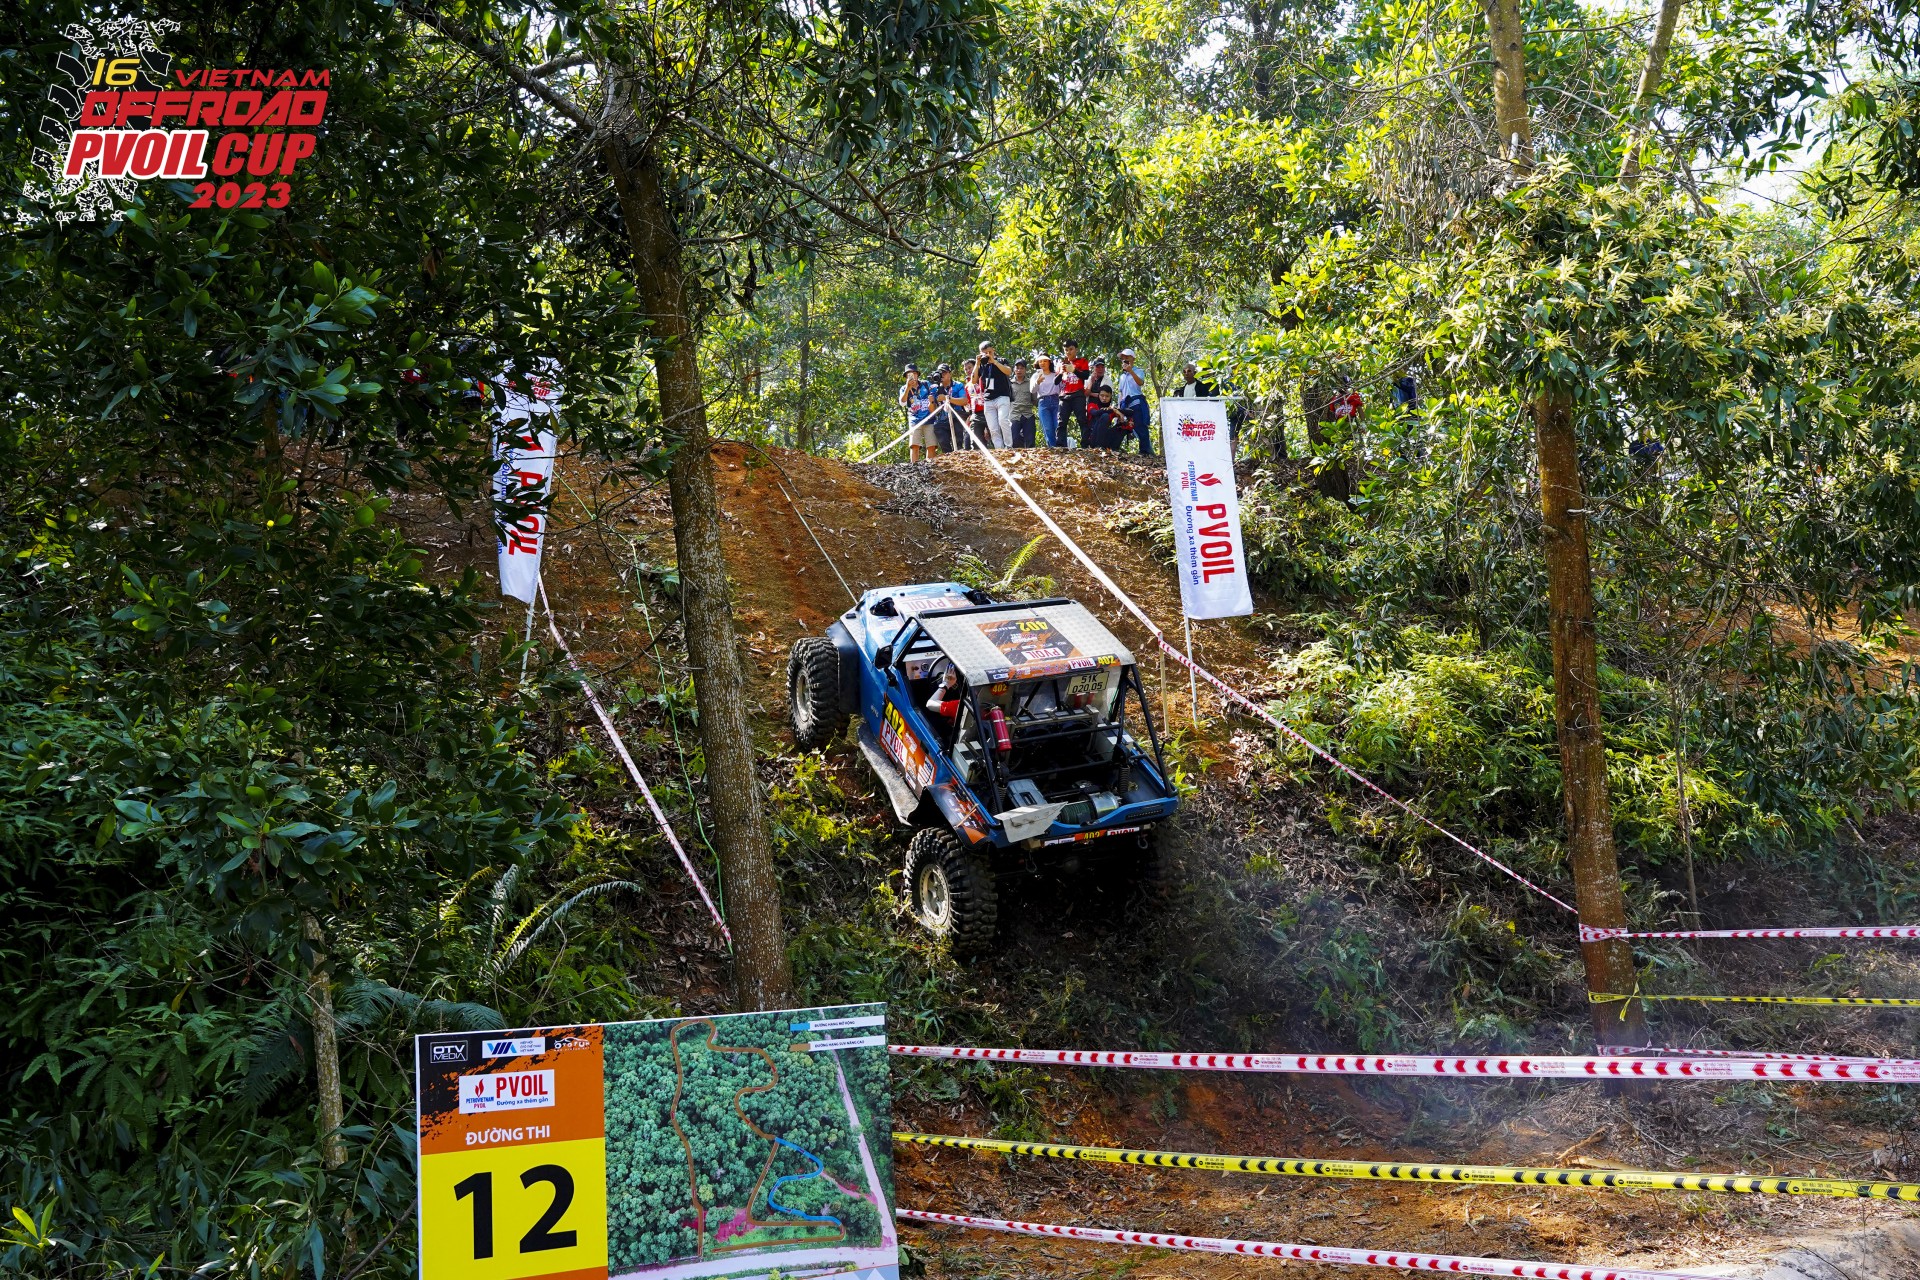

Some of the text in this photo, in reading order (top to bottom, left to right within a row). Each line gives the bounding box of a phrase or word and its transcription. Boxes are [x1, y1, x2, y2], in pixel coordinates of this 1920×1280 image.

[1202, 429, 1216, 437] CUP
[1180, 471, 1190, 491] PVOIL
[1187, 461, 1198, 502] PETROVIETNAM
[1188, 535, 1196, 546] xa
[1196, 503, 1235, 584] PVOIL
[902, 598, 947, 611] PVOIL
[1015, 620, 1048, 632] 402
[1026, 648, 1060, 659] PVOIL
[1070, 655, 1117, 668] PVOIL 402
[1081, 675, 1098, 683] 51K
[992, 684, 1008, 694] 402
[885, 701, 905, 740] 402
[885, 723, 904, 763] PVOIL
[433, 1044, 465, 1054] OTV
[433, 1052, 466, 1061] MEDIA
[496, 1074, 548, 1099] PVOIL
[465, 1096, 495, 1104] PETROVIETNAM
[465, 1125, 551, 1146] ĐƯỜNG THI
[453, 1164, 578, 1260] 12
